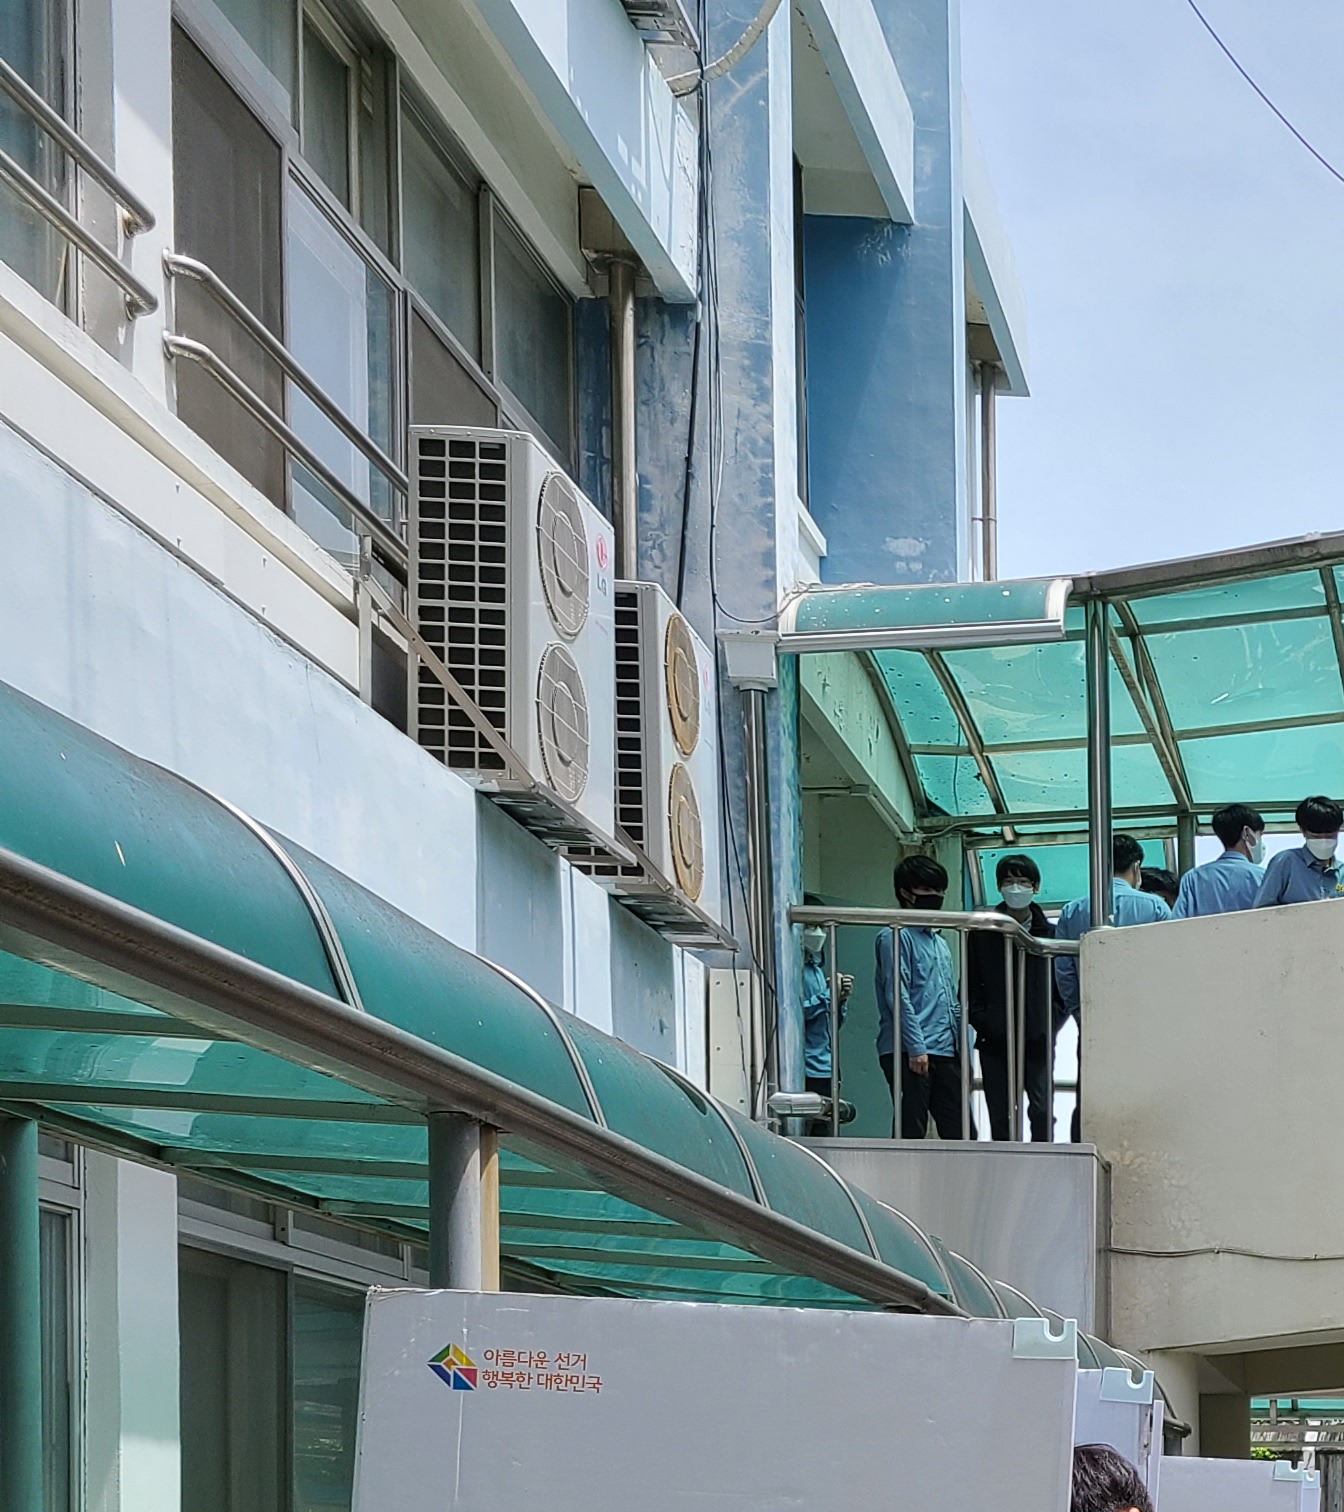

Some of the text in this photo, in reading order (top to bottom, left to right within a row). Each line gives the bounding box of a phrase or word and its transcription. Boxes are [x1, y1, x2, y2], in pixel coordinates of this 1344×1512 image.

[596, 573, 607, 597] LG
[483, 1349, 587, 1371] 아름다운 선거
[481, 1369, 603, 1394] 행복한 대한민국
